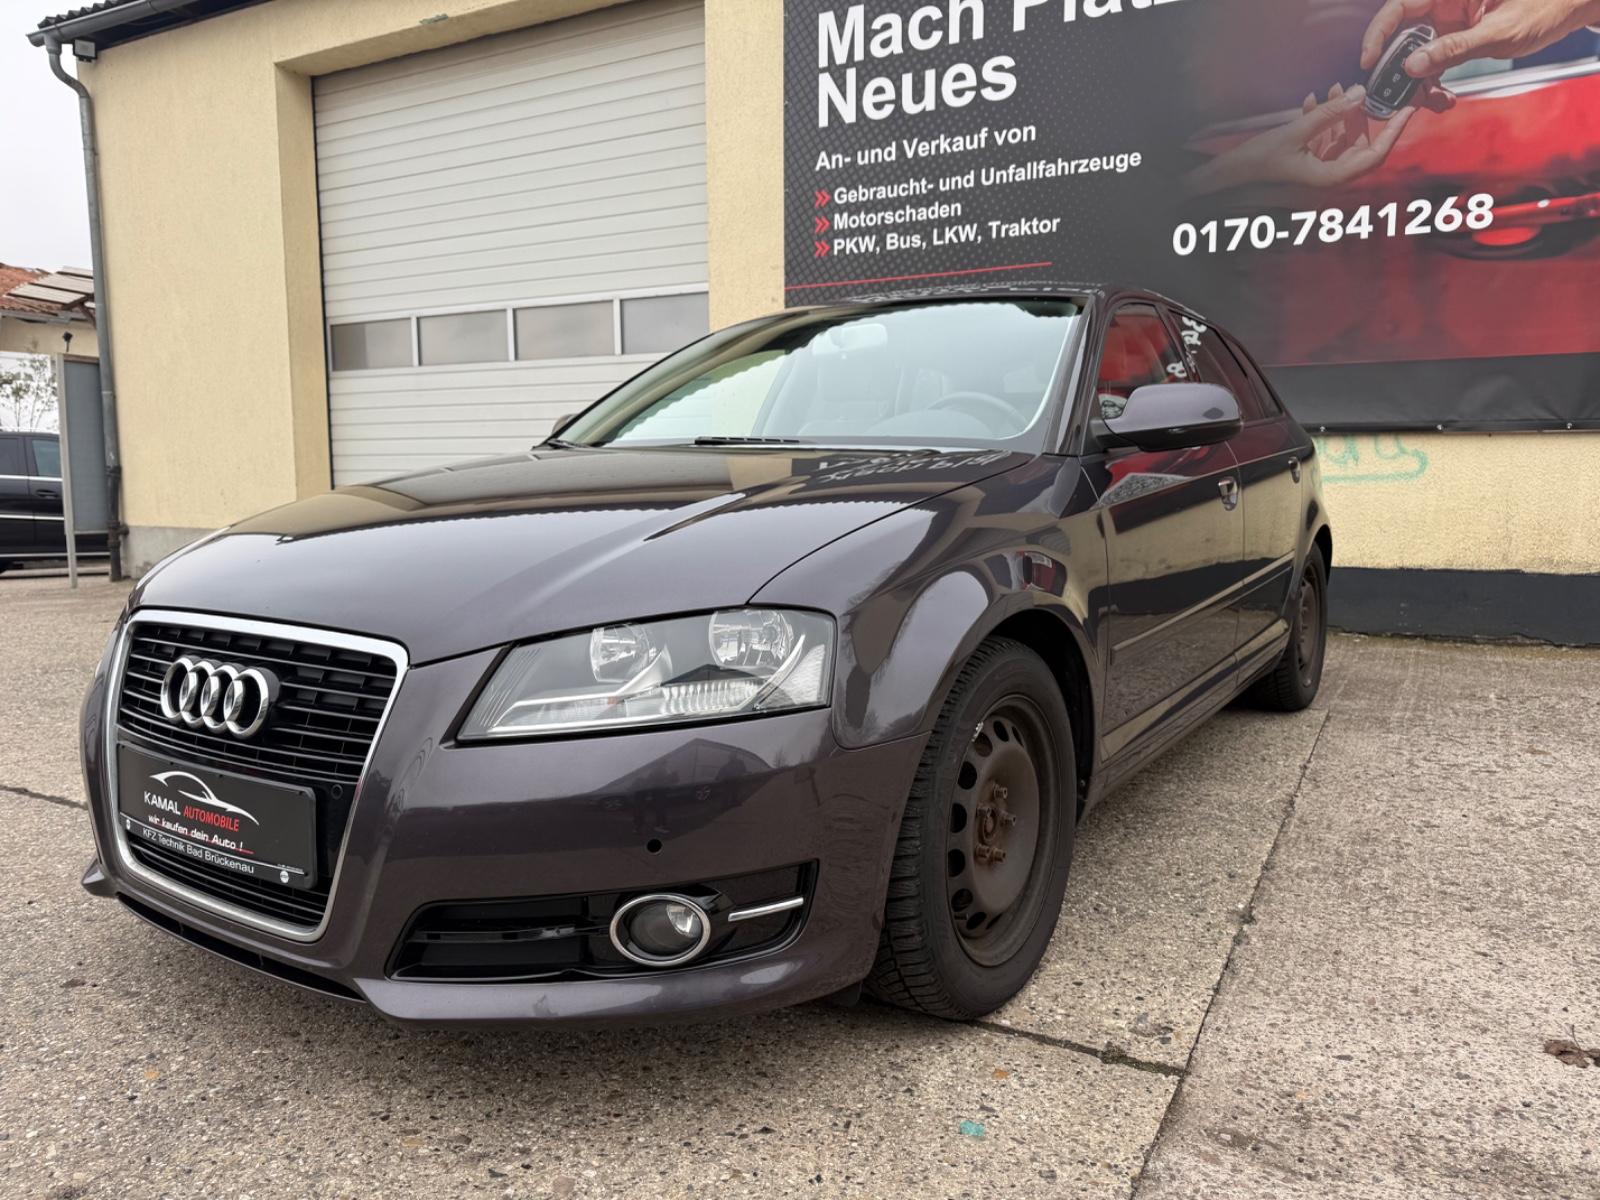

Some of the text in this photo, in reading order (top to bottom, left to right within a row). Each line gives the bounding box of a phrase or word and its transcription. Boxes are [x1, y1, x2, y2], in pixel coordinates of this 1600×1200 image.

[819, 0, 984, 68] Mach
[818, 55, 1018, 128] Neues
[815, 125, 1036, 171] An- und Verkauf von
[834, 151, 1142, 205] Gebraucht- und Unfallfahrzeuge
[833, 215, 1060, 256] PKW, Bus, LKW, Traktor
[834, 202, 961, 231] Motorschaden
[1172, 193, 1494, 256] 0170-7841268
[144, 791, 239, 832] KAMAL AUTOMOBILE
[148, 815, 160, 825] wir
[161, 818, 188, 836] kaufen
[190, 827, 209, 842] dein
[212, 834, 236, 850] Auto
[142, 828, 255, 874] KFZ Technik Bad Brückenau
